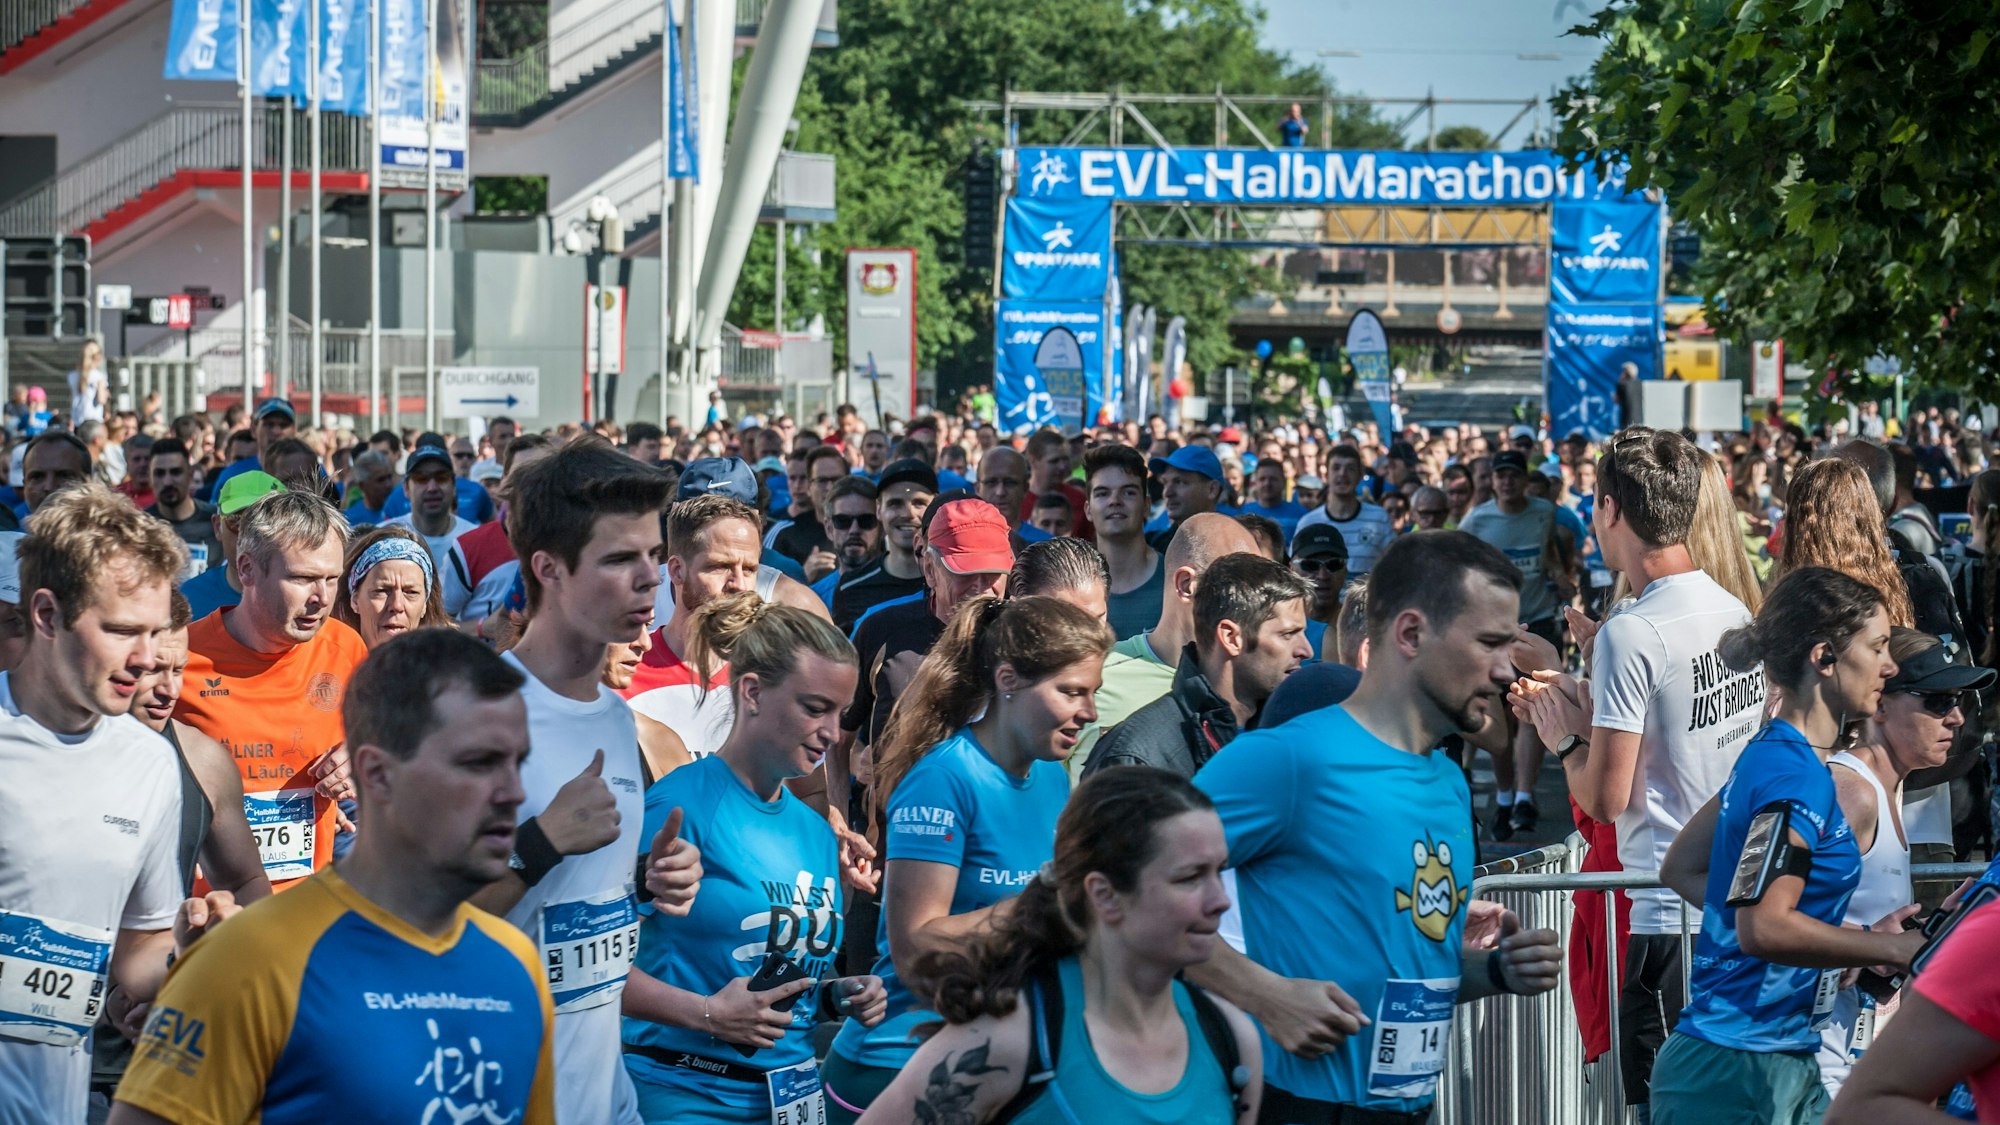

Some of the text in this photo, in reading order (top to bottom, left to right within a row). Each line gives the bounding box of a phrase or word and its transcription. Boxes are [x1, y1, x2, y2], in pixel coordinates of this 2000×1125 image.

[1080, 151, 1586, 199] EVL-HalbMarathon
[1013, 251, 1101, 269] SPORTPARK
[445, 371, 536, 386] DURCHGANG
[200, 688, 230, 698] erima
[1688, 670, 1765, 732] JUST BRIDGES
[247, 764, 295, 780] Läufe
[760, 880, 834, 909] WILLST
[766, 905, 838, 958] DU
[574, 933, 622, 968] 1115
[24, 967, 74, 1000] 402
[31, 1002, 57, 1018] WILL
[362, 991, 515, 1013] EVL-HalbMarathon
[1420, 1026, 1439, 1053] 14
[691, 1056, 729, 1075] bunert
